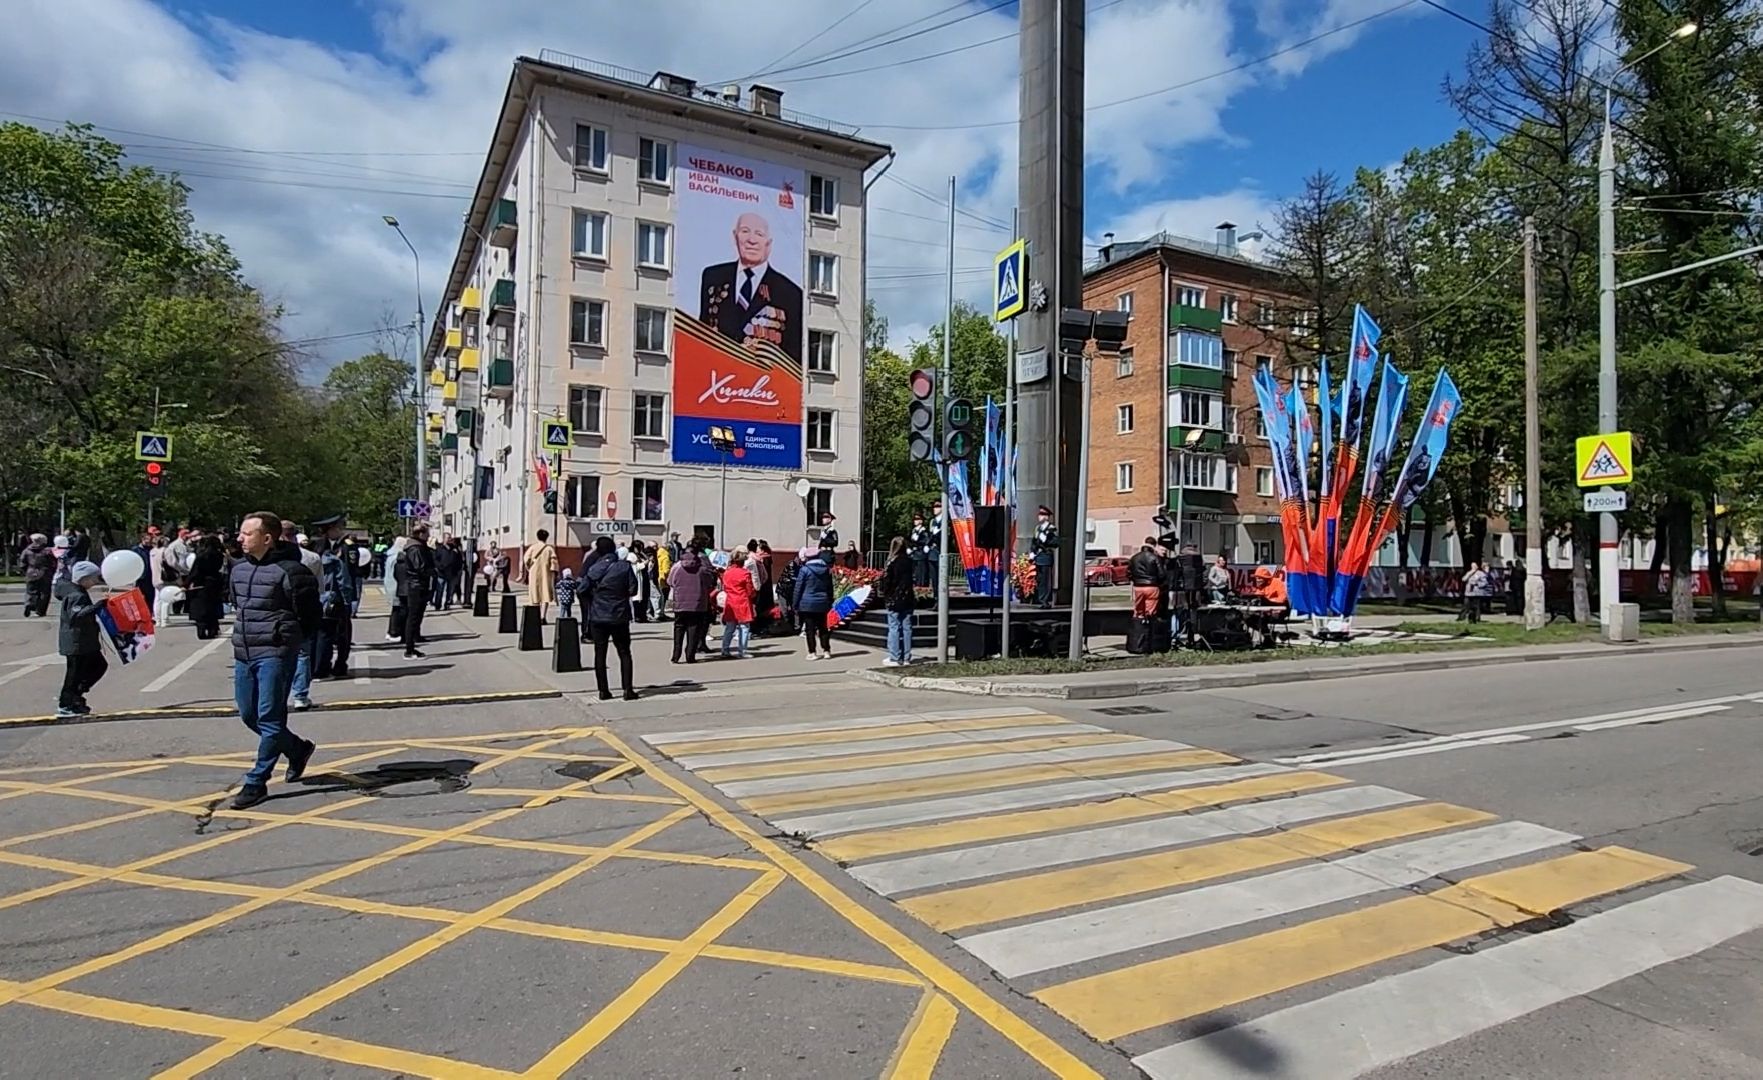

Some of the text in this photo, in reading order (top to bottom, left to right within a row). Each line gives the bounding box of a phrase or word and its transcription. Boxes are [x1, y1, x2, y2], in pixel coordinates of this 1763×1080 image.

[689, 156, 754, 180] ЧЕБАКОВ
[689, 172, 719, 185] ИВАН
[689, 182, 759, 203] ВАСИЛЬЕВИЧ
[698, 369, 779, 405] Химки
[745, 436, 778, 444] ЕДИНСТВЕ
[745, 442, 784, 450] ПОКОЛЕНИЙ
[596, 522, 628, 532] СТОП
